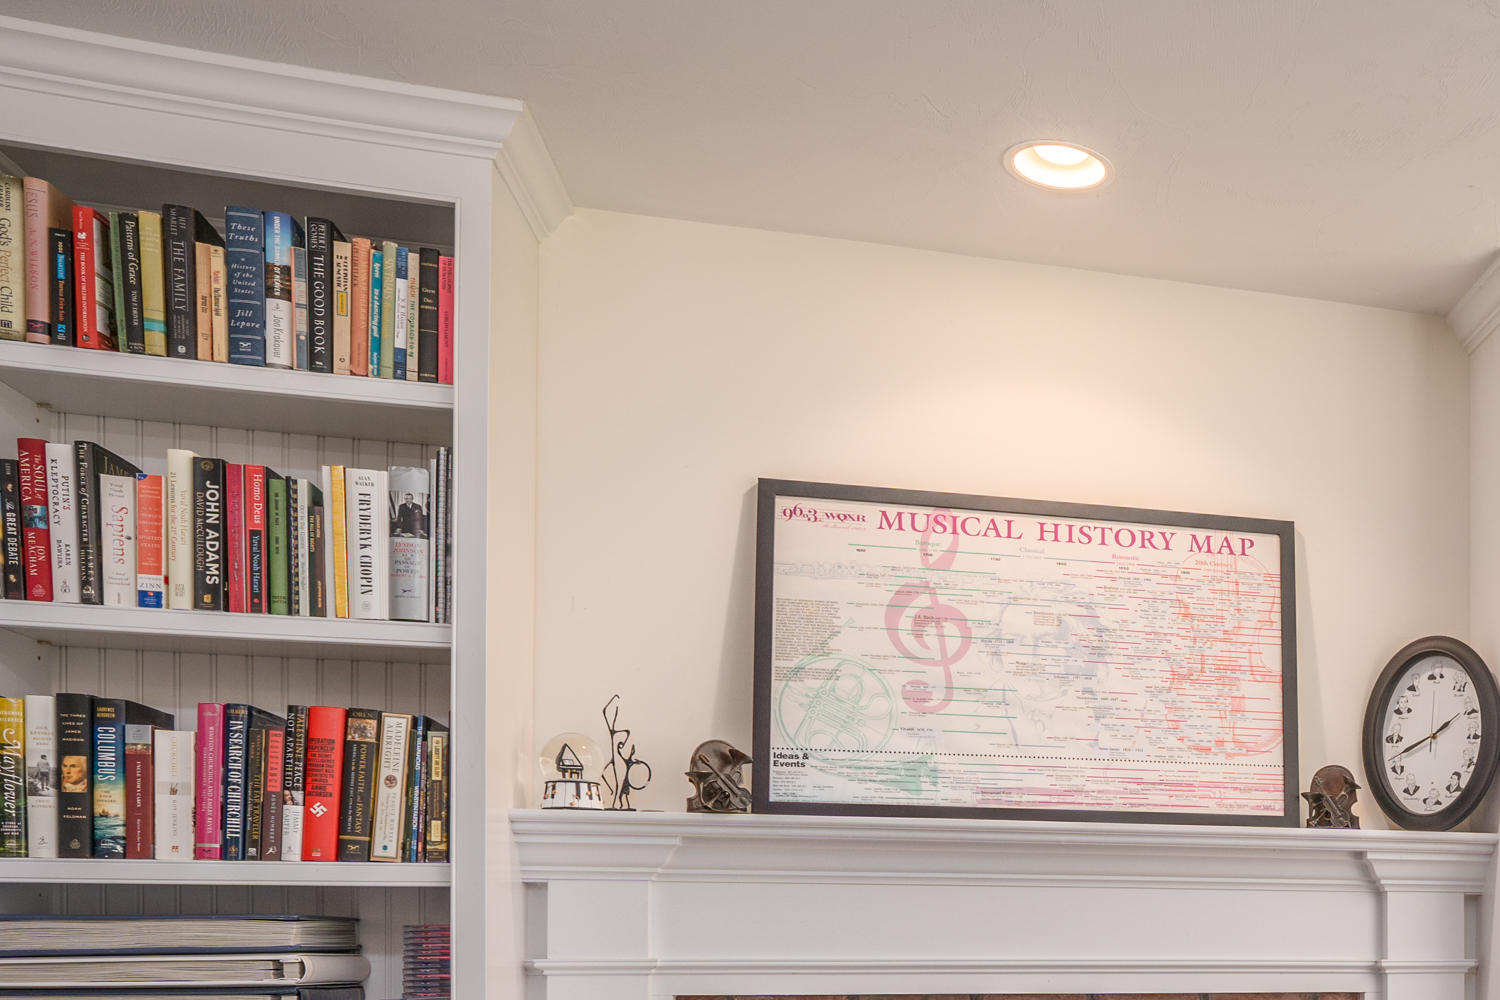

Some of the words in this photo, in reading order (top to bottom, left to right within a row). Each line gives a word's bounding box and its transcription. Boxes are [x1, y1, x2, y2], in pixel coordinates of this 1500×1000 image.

[0, 218, 12, 246] God's
[125, 220, 138, 251] Patterns
[228, 232, 259, 243] Truths
[230, 222, 257, 232] These
[273, 216, 281, 233] UNDER
[0, 249, 12, 283] Perfect
[128, 252, 139, 261] of
[173, 241, 185, 262] THE
[129, 263, 139, 285] Grace
[313, 255, 325, 278] THE
[1, 286, 13, 313] Child
[173, 268, 186, 312] FAMILY
[313, 281, 325, 316] GOOD
[230, 320, 261, 329] Lepore
[235, 310, 253, 318] Jill
[273, 315, 283, 327] Jon
[273, 328, 283, 358] Krakauer
[314, 319, 326, 354] BOOK
[19, 449, 30, 502] AMERICA
[33, 464, 45, 493] SOUL
[254, 474, 262, 500] Homo
[50, 458, 60, 526] KLEPTOCRACY
[62, 475, 71, 511] PUTIN'S
[205, 481, 219, 524] JOHN
[6, 512, 16, 534] GREAT
[254, 503, 262, 524] Deus
[358, 493, 372, 550] FRYDERYK
[824, 512, 866, 523] WQXR
[106, 504, 129, 565] Sapiens
[196, 518, 204, 571] McCULLOUGH
[252, 535, 260, 552] Yuval
[877, 510, 1024, 540] MUSICAL
[1036, 521, 1177, 551] HISTORY
[1188, 533, 1255, 557] MAP
[7, 537, 18, 565] DEBATE
[27, 532, 37, 576] MEACHAM
[36, 545, 45, 561] JON
[206, 529, 220, 585] ADAMS
[359, 555, 373, 595] CHOPIN
[229, 720, 242, 731] IN
[295, 713, 304, 759] PALESTINE
[97, 726, 116, 781] COLUMBUS
[228, 732, 242, 769] SEARCH
[358, 744, 367, 771] POWER,
[384, 724, 393, 770] ALBRIGHT
[392, 721, 403, 774] MADELEINE
[773, 752, 800, 760] Ideas
[3, 728, 23, 817] Mayflower
[285, 736, 293, 788] APARTHEID
[293, 761, 301, 788] PEACE
[773, 760, 806, 768] Events
[228, 772, 242, 784] OF
[357, 771, 365, 792] FAITH
[227, 785, 241, 839] CHURCHILL
[355, 803, 363, 833] FANTASY
